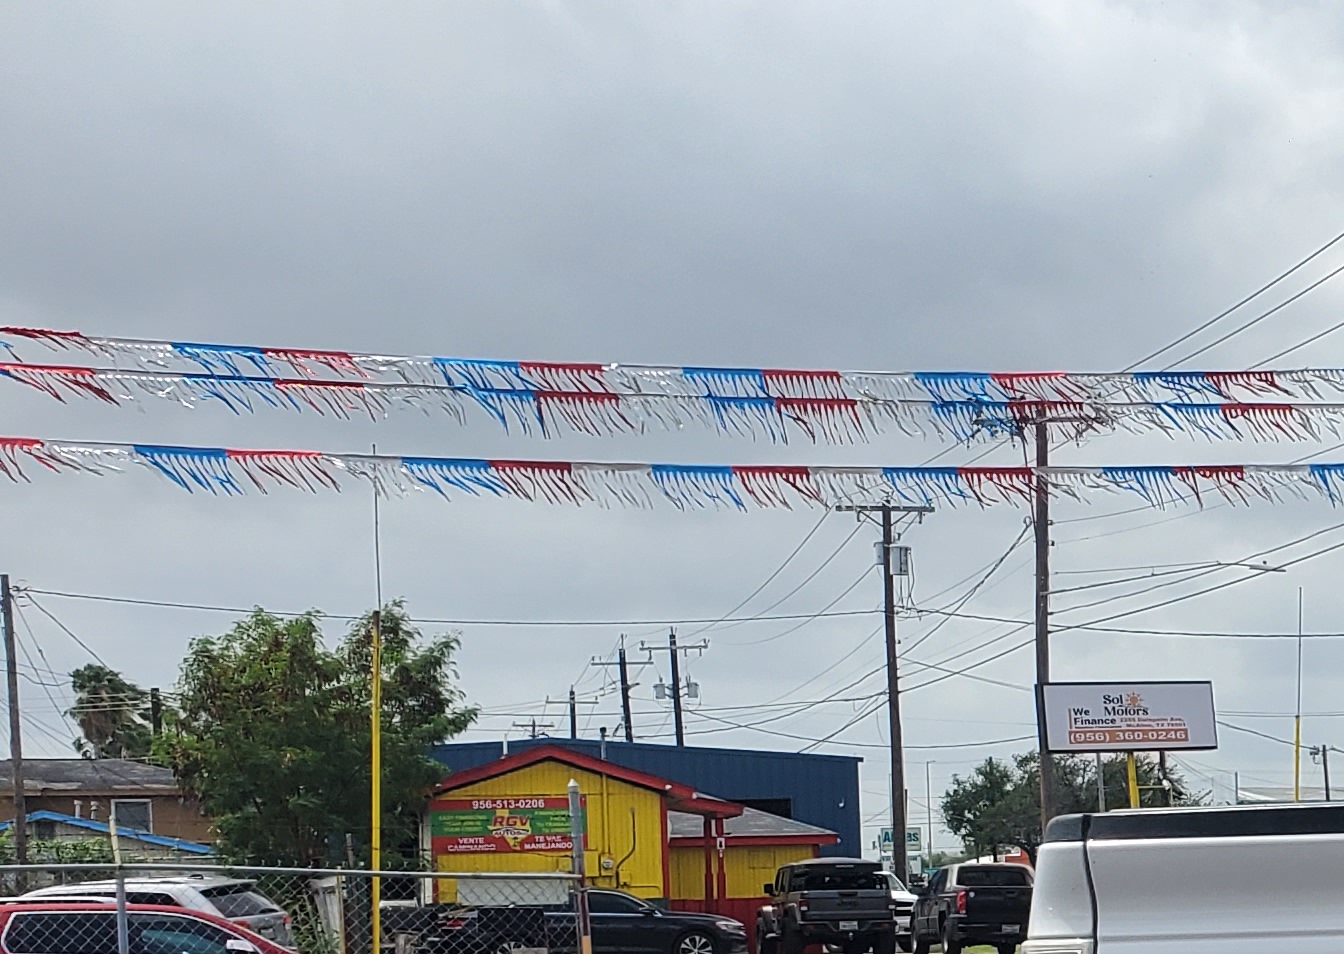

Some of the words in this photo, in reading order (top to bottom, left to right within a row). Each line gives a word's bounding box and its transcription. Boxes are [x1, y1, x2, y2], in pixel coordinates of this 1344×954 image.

[1102, 694, 1124, 705] Sol
[1072, 707, 1090, 716] We
[1104, 705, 1149, 717] Motors
[1073, 717, 1117, 726] Finance
[1070, 732, 1110, 743] (956)
[1115, 730, 1186, 741] 360-0246
[492, 815, 530, 827] RGV
[524, 842, 573, 850] MANEJANDO
